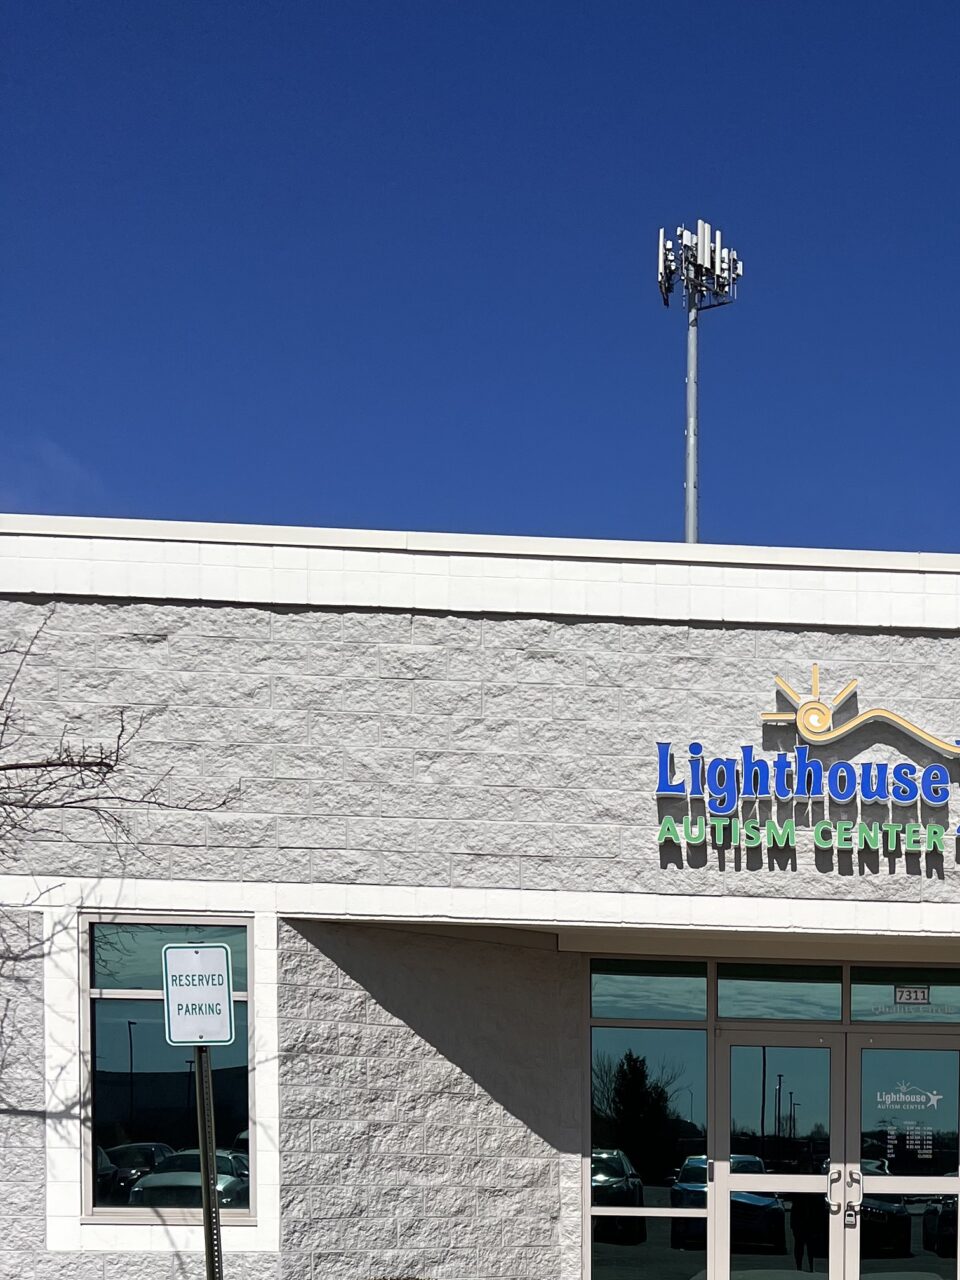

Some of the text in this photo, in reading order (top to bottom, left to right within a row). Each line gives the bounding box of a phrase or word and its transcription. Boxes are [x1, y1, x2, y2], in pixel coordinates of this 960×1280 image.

[655, 741, 950, 815] Lighthouse
[657, 816, 946, 852] AUTISM CENTER
[171, 974, 224, 986] RESERVED
[896, 990, 928, 1001] 7311
[177, 1003, 221, 1015] PARKING
[876, 1091, 926, 1105] Lighthouse
